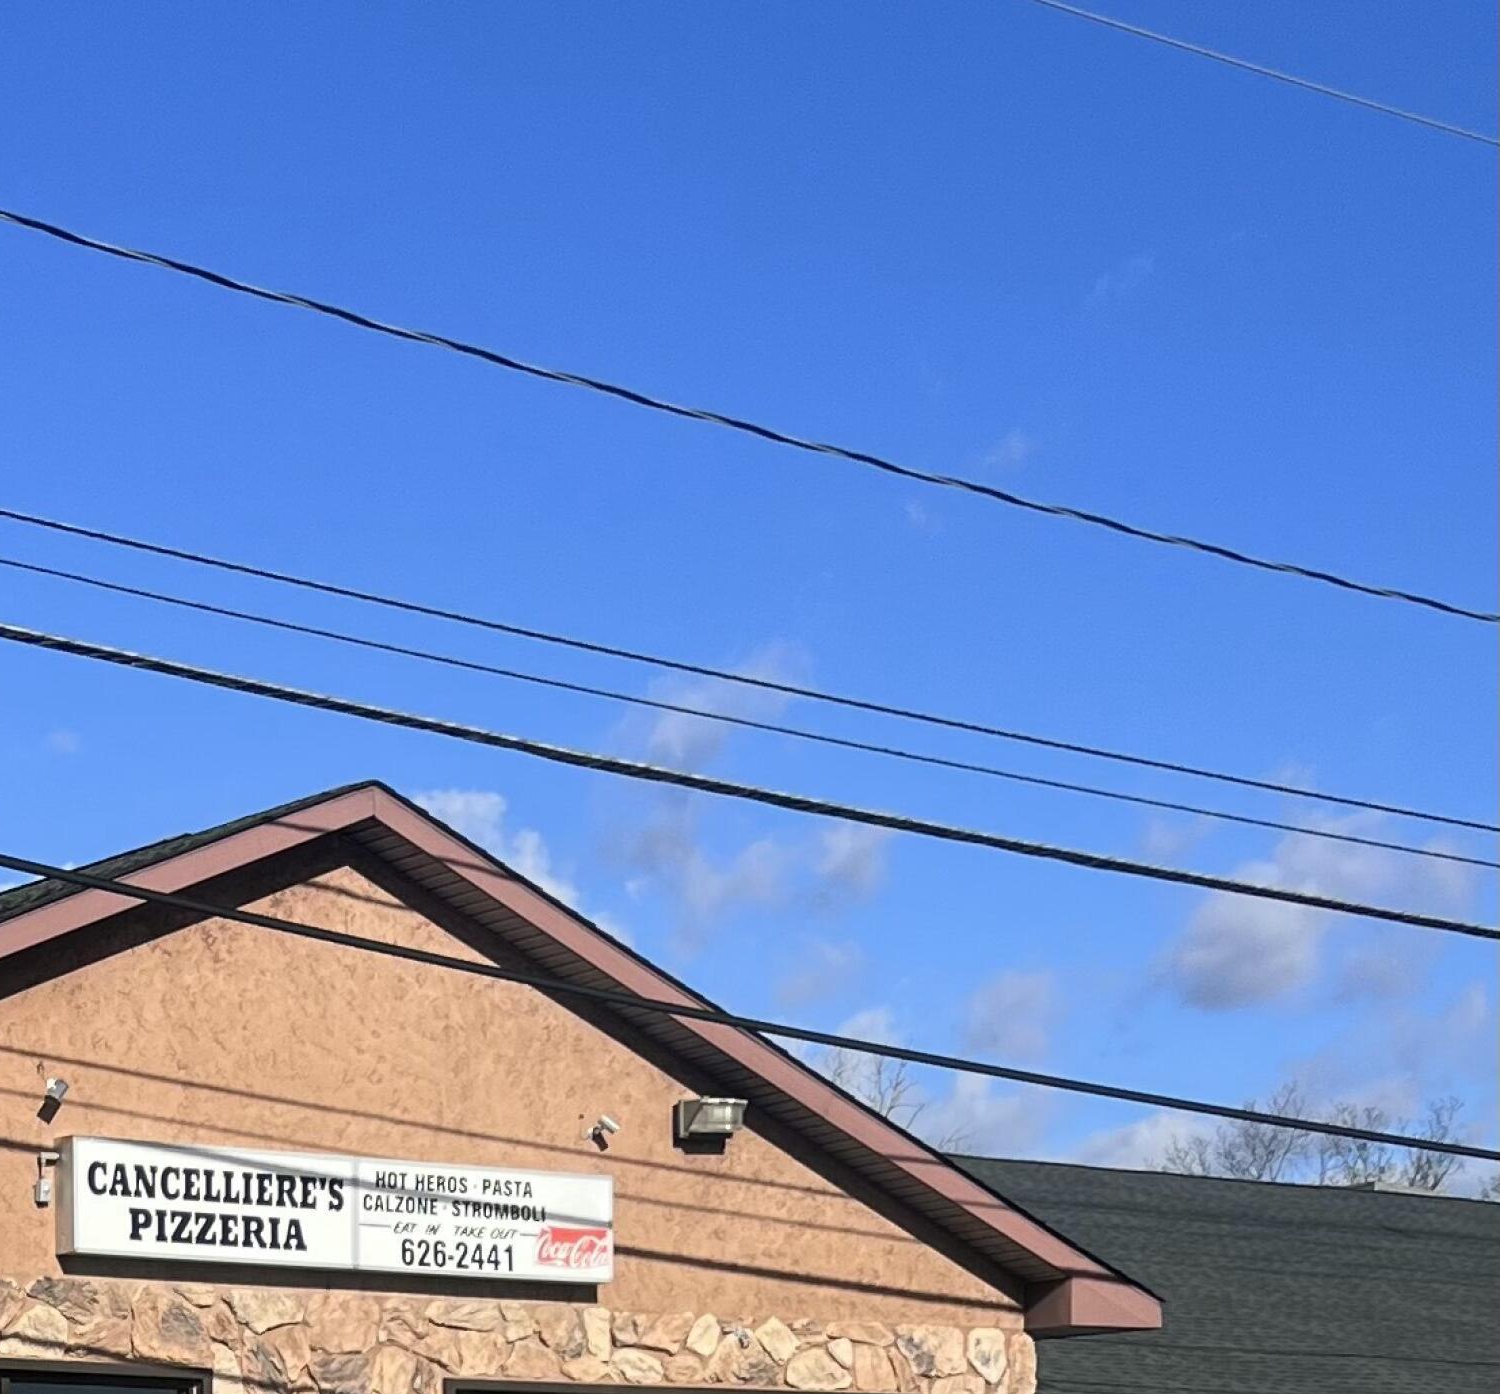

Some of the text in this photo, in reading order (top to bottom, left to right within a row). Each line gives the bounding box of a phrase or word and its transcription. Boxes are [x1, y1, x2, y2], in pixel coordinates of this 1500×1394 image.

[87, 1161, 345, 1211] CANCELLIERE'S
[375, 1170, 533, 1198] HOT HEROS PASTA
[363, 1194, 546, 1222] CALZONE STROMBOLI
[129, 1207, 308, 1251] PIZZERIA
[394, 1222, 418, 1234] EAT
[454, 1225, 486, 1239] TAKE
[490, 1228, 519, 1240] OUT
[401, 1238, 514, 1272] 626-2441
